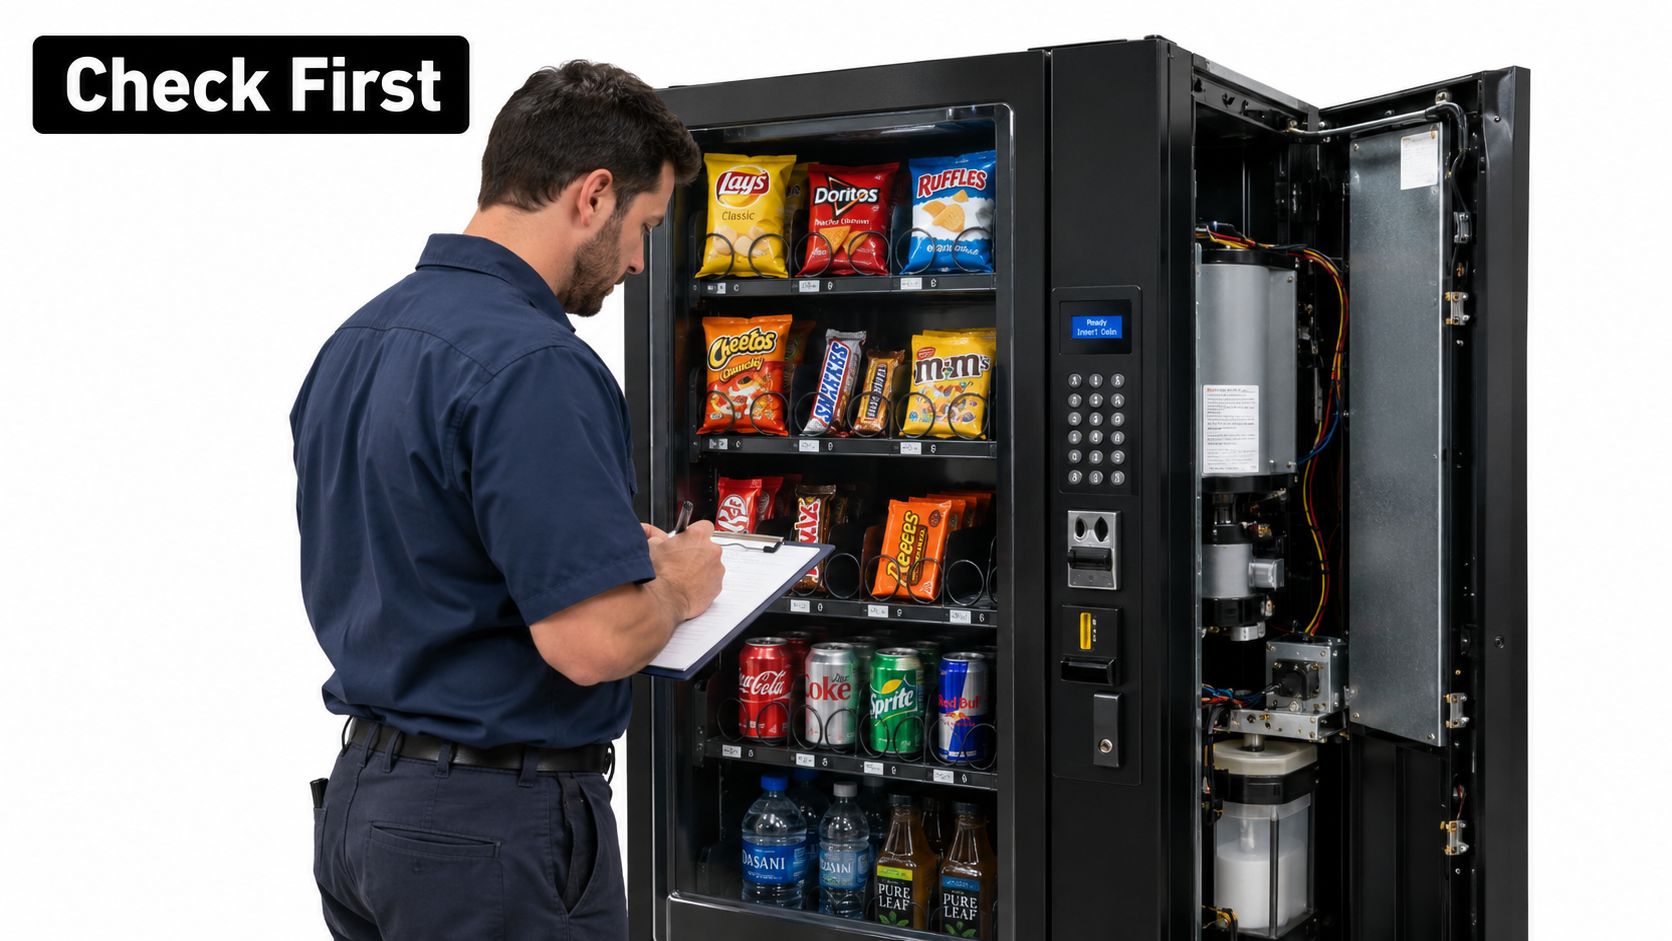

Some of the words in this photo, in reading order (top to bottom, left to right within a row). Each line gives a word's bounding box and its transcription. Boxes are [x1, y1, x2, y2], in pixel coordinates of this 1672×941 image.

[917, 168, 987, 198] RUFFLES
[814, 187, 879, 204] Doritos
[722, 211, 755, 221] Classic
[708, 328, 777, 371] Cheetos
[870, 687, 914, 719] Sprite
[959, 695, 982, 709] Bul
[742, 849, 785, 870] DASANI
[878, 883, 911, 899] PURE
[879, 896, 911, 911] LEAF
[943, 893, 978, 910] PURE
[944, 906, 978, 921] LEAF
